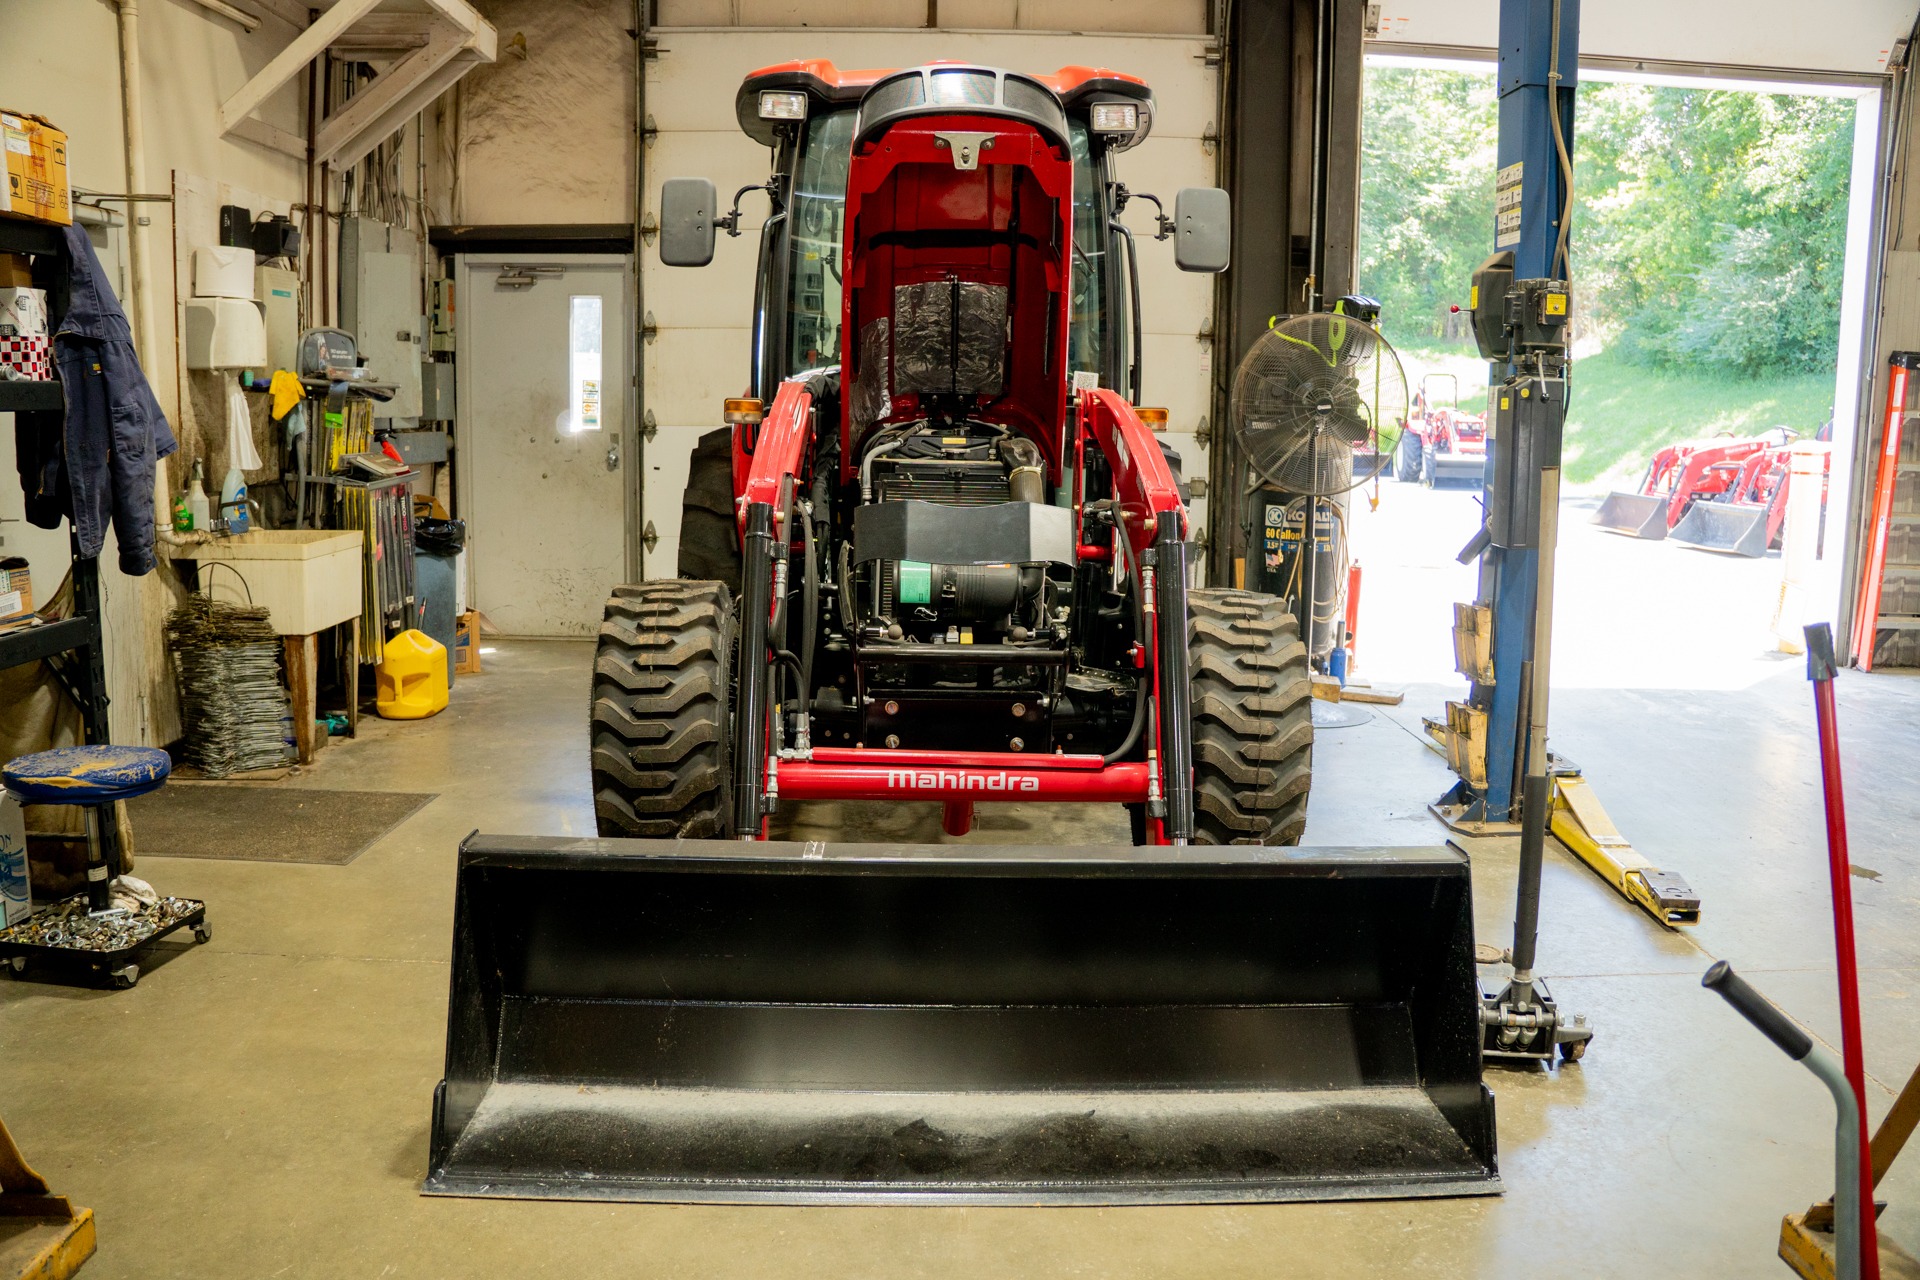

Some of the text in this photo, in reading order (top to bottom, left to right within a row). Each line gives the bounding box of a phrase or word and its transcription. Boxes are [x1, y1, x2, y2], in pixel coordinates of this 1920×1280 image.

[1287, 511, 1333, 521] KOALT
[1266, 528, 1300, 540] 60 Gallon
[888, 769, 1039, 791] Mahindra
